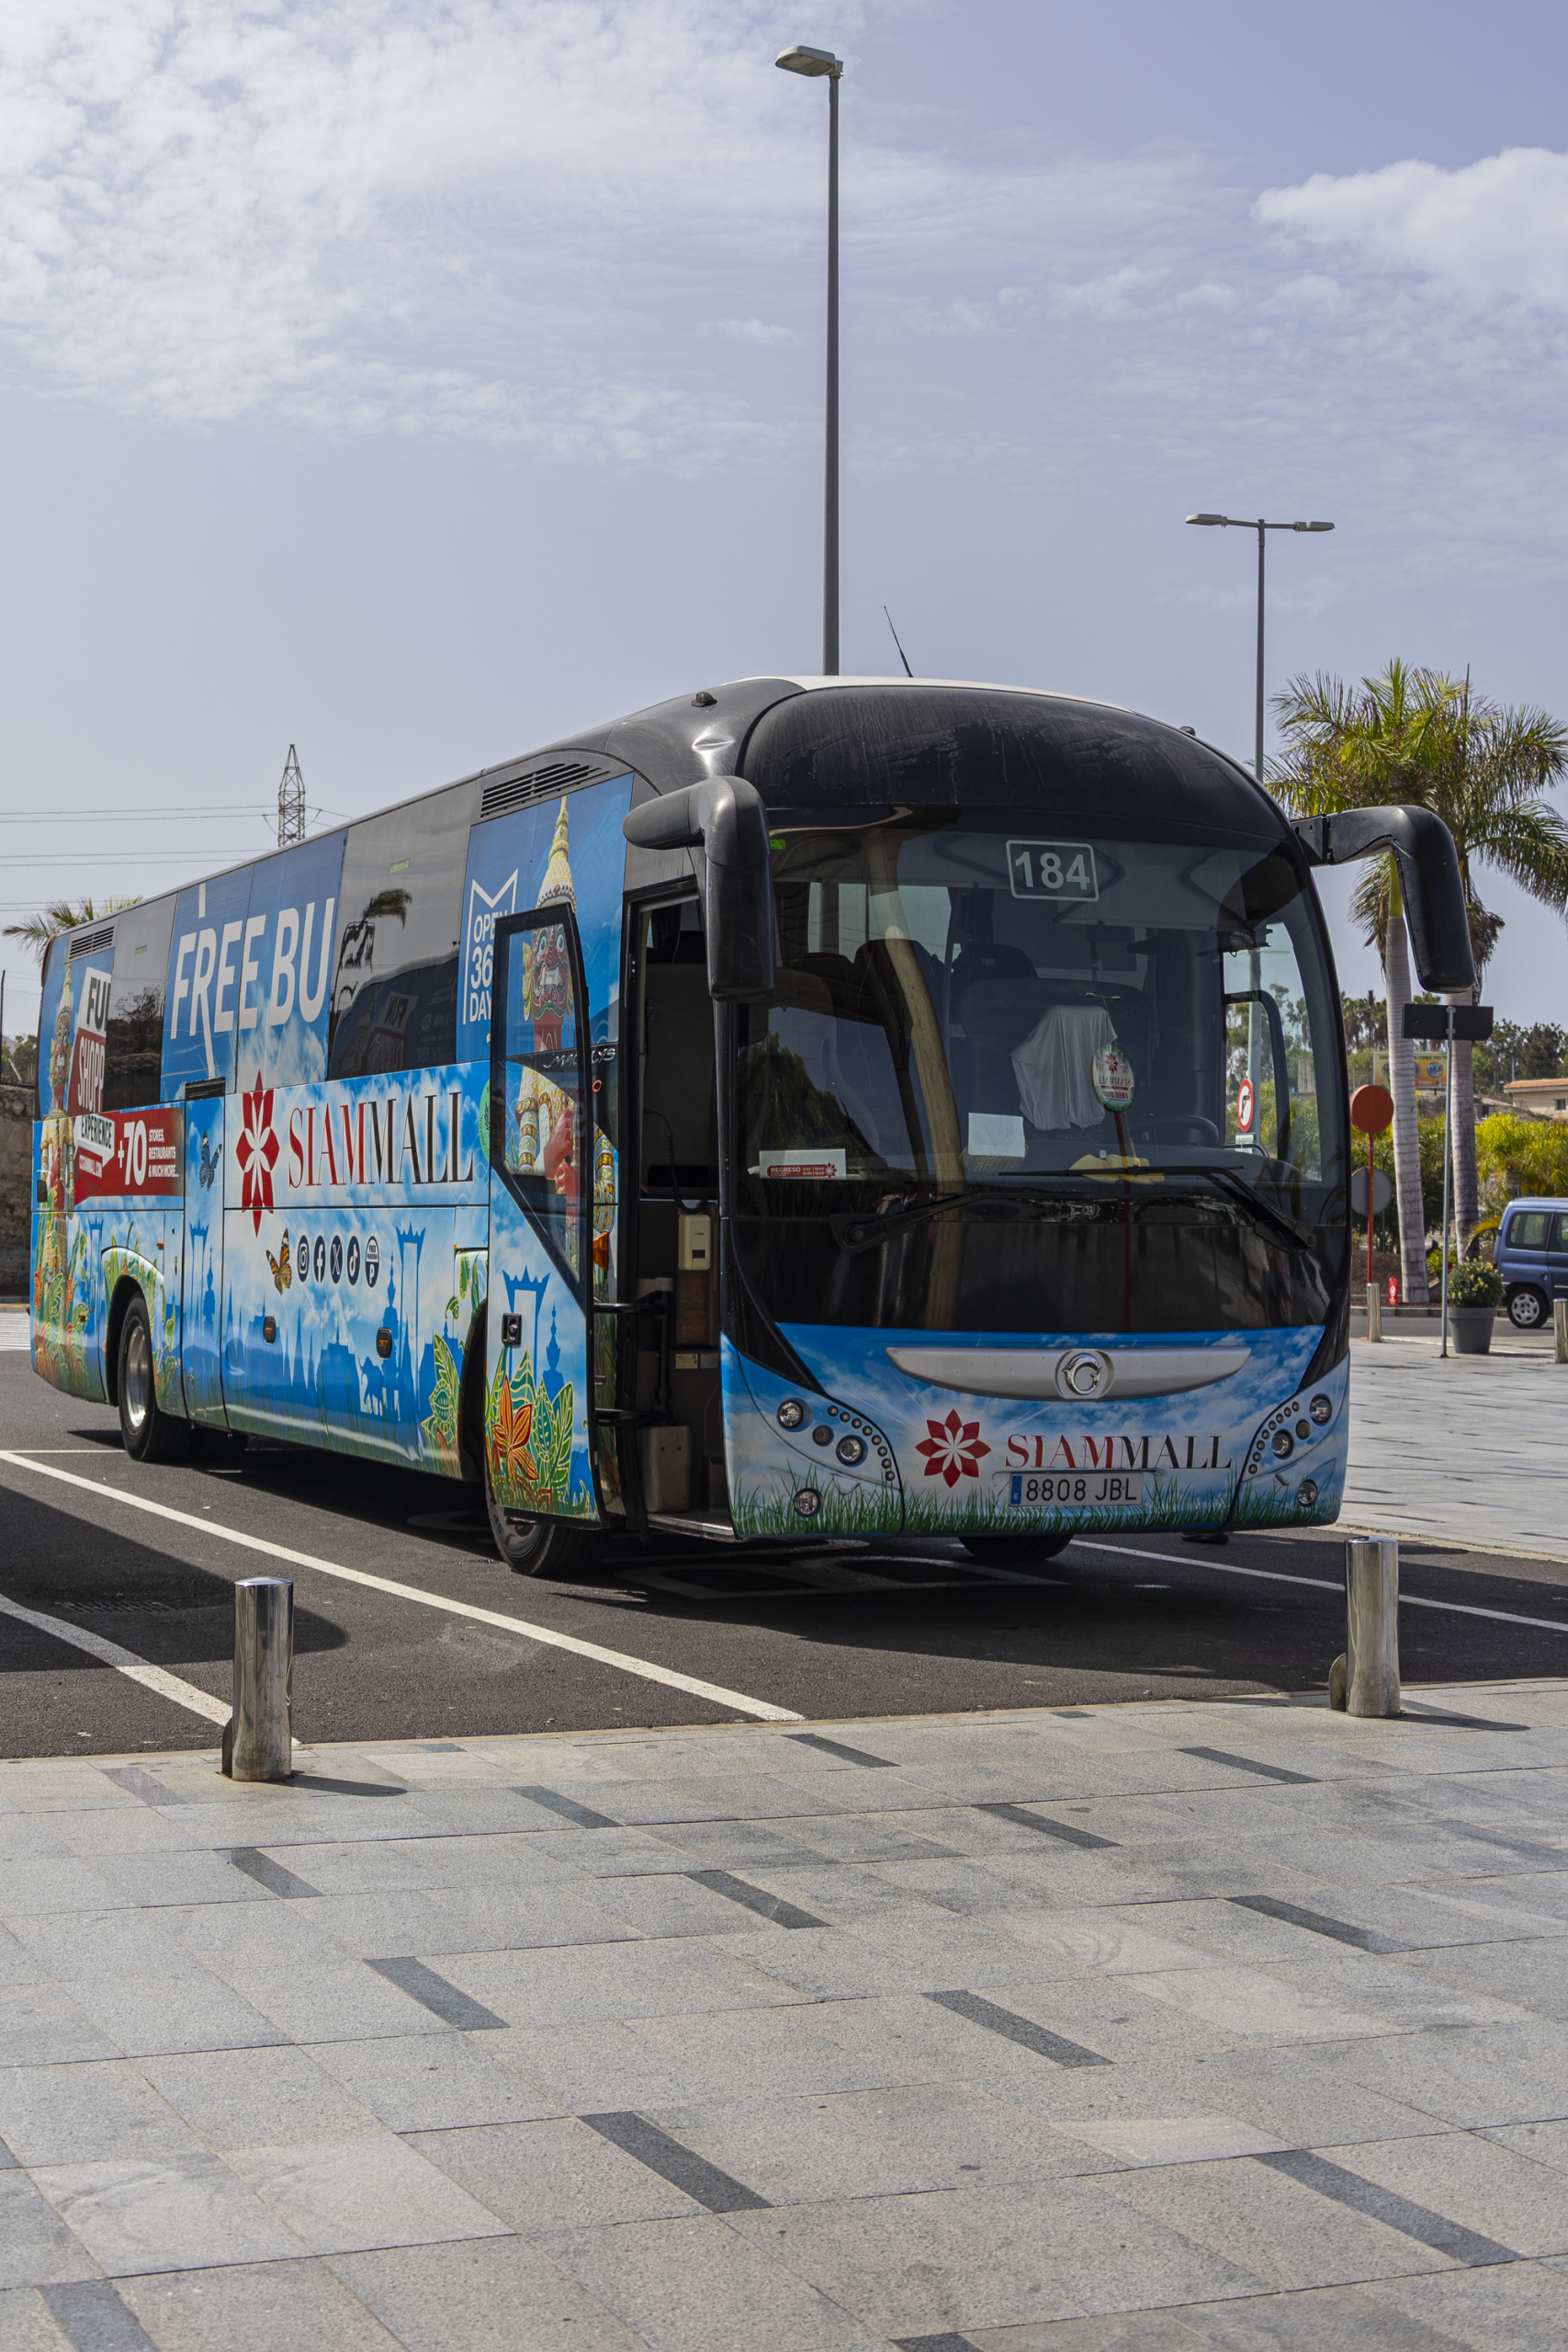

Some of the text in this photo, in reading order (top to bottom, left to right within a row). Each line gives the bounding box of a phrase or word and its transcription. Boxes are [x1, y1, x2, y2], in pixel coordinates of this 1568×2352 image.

[1015, 851, 1090, 890] 184
[474, 910, 507, 944] OPE
[470, 944, 494, 989] 36
[171, 898, 335, 1080] FREE BU
[469, 990, 492, 1023] DAY
[81, 1114, 112, 1149] EXPERIENCE
[148, 1146, 176, 1159] RESTAURANTS
[1013, 1492, 1019, 1500] E
[1026, 1477, 1137, 1501] 8808 JBL
